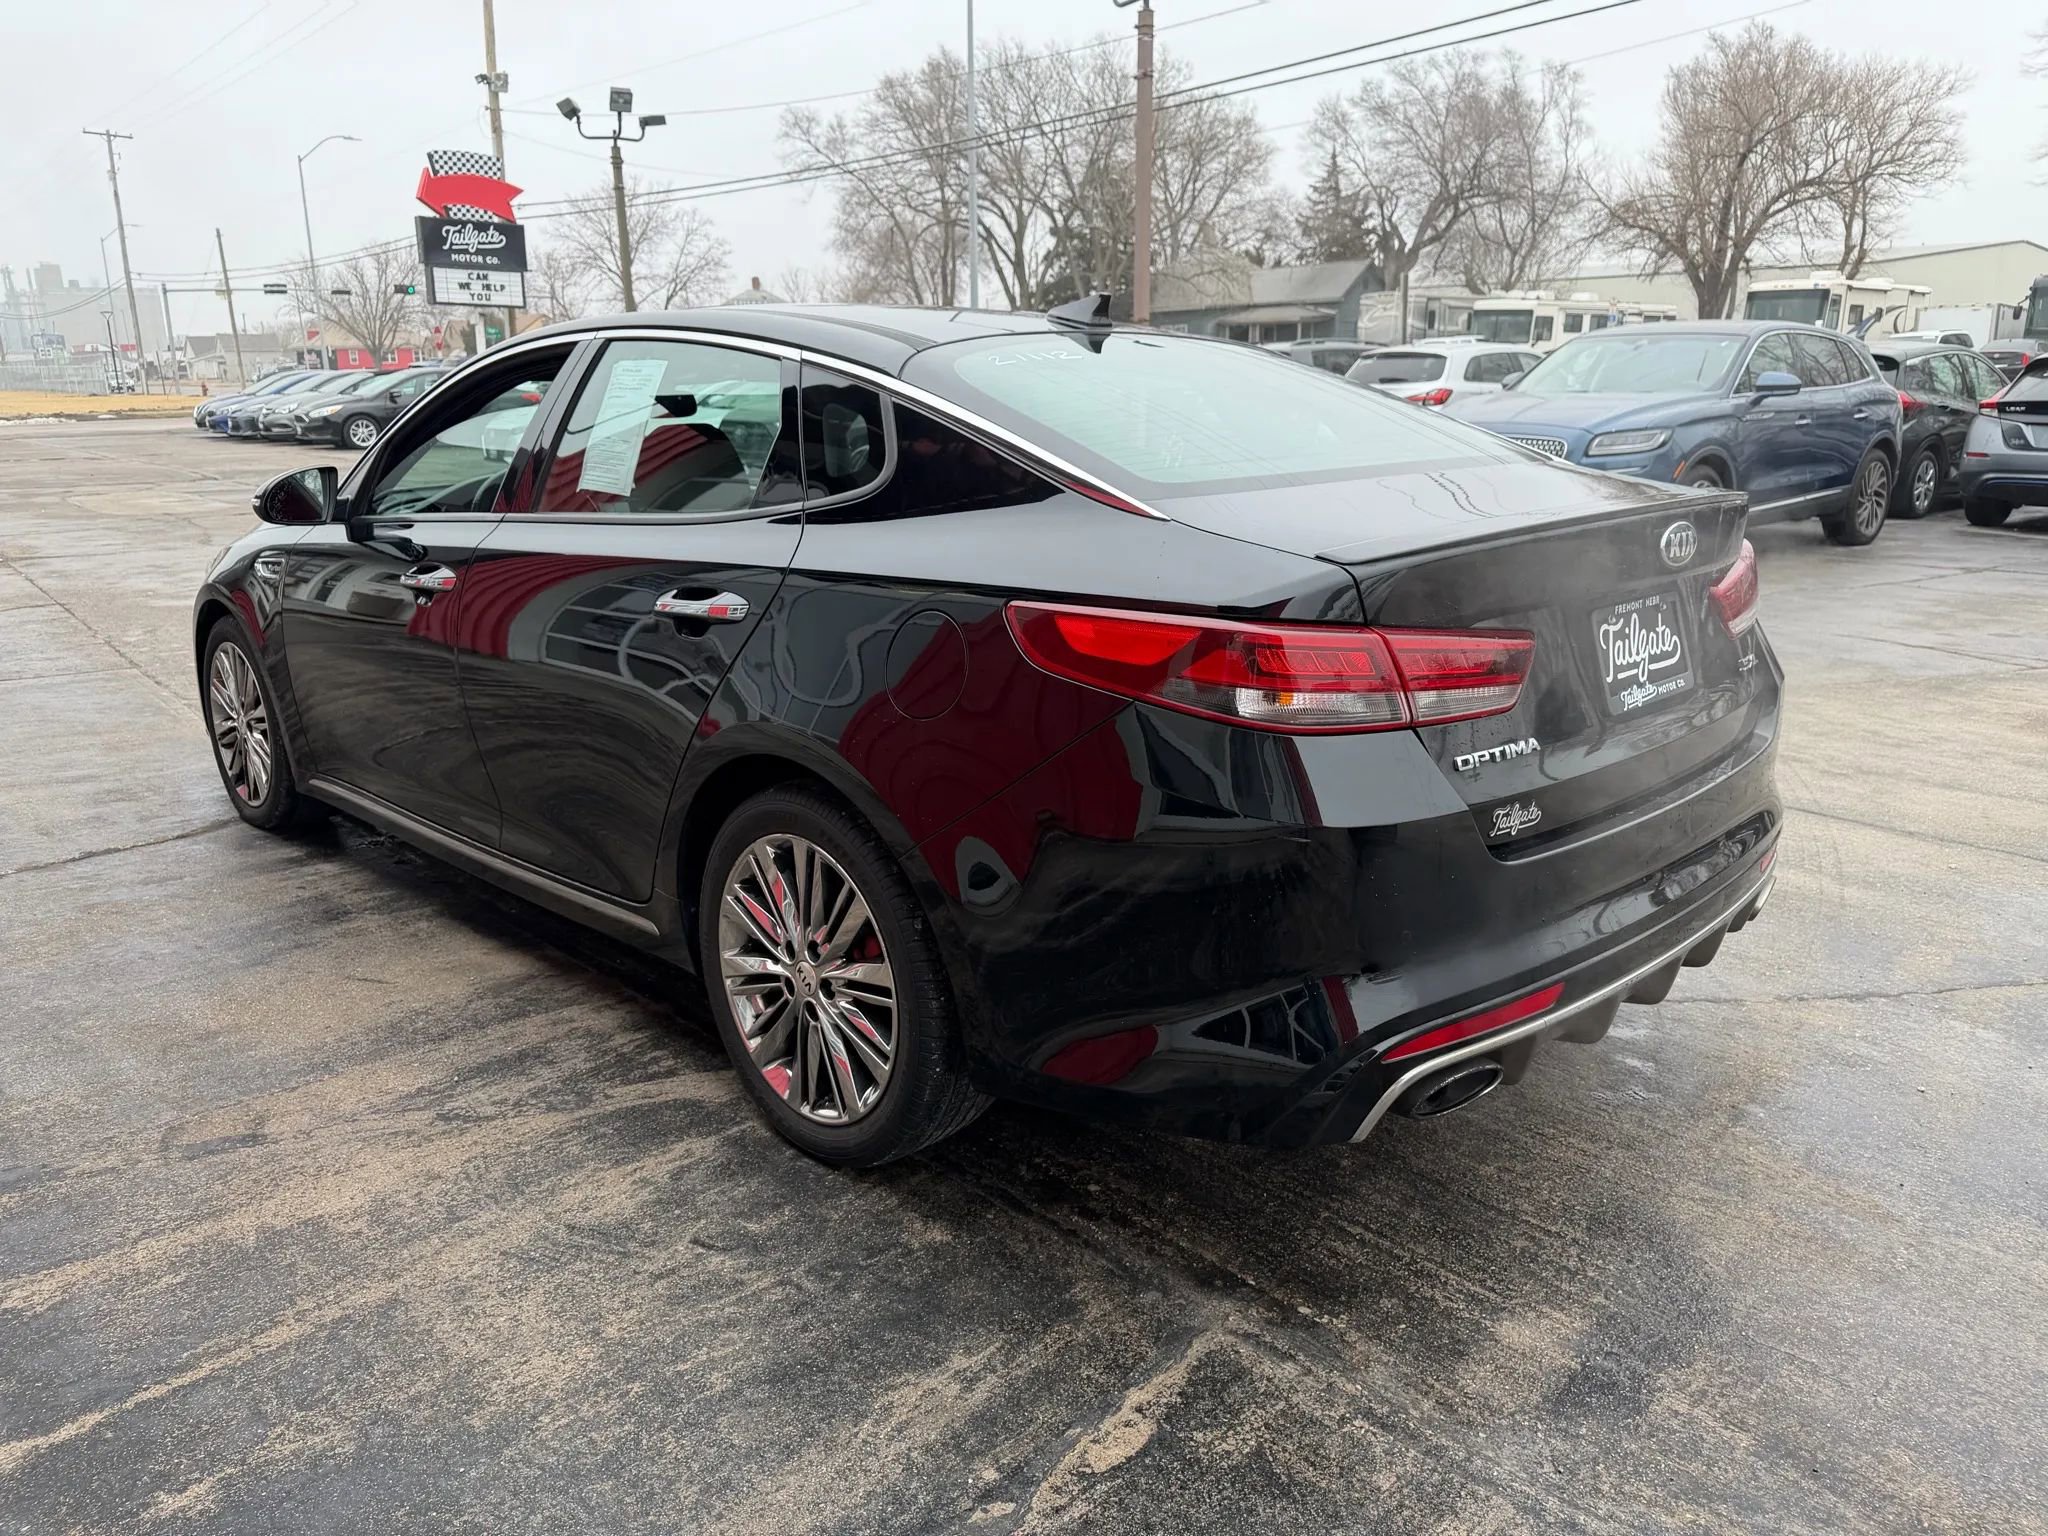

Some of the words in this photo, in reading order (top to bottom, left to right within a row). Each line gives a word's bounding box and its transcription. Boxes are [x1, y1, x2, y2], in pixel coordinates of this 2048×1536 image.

[442, 223, 506, 252] Tailgate
[451, 254, 483, 263] MOTOR
[486, 255, 500, 264] CO.
[458, 282, 472, 291] WE
[482, 283, 506, 292] HELP
[467, 272, 489, 281] CAN
[469, 292, 491, 302] YOU
[1669, 530, 1694, 558] KIA
[1615, 599, 1643, 615] FREMONT
[1599, 612, 1681, 684] Tailgate
[1620, 681, 1658, 711] Tailgate
[1658, 682, 1677, 695] MOTOR
[1453, 737, 1542, 772] OPTIMA
[1489, 801, 1542, 837] Tailgate
[797, 966, 811, 992] KIA
